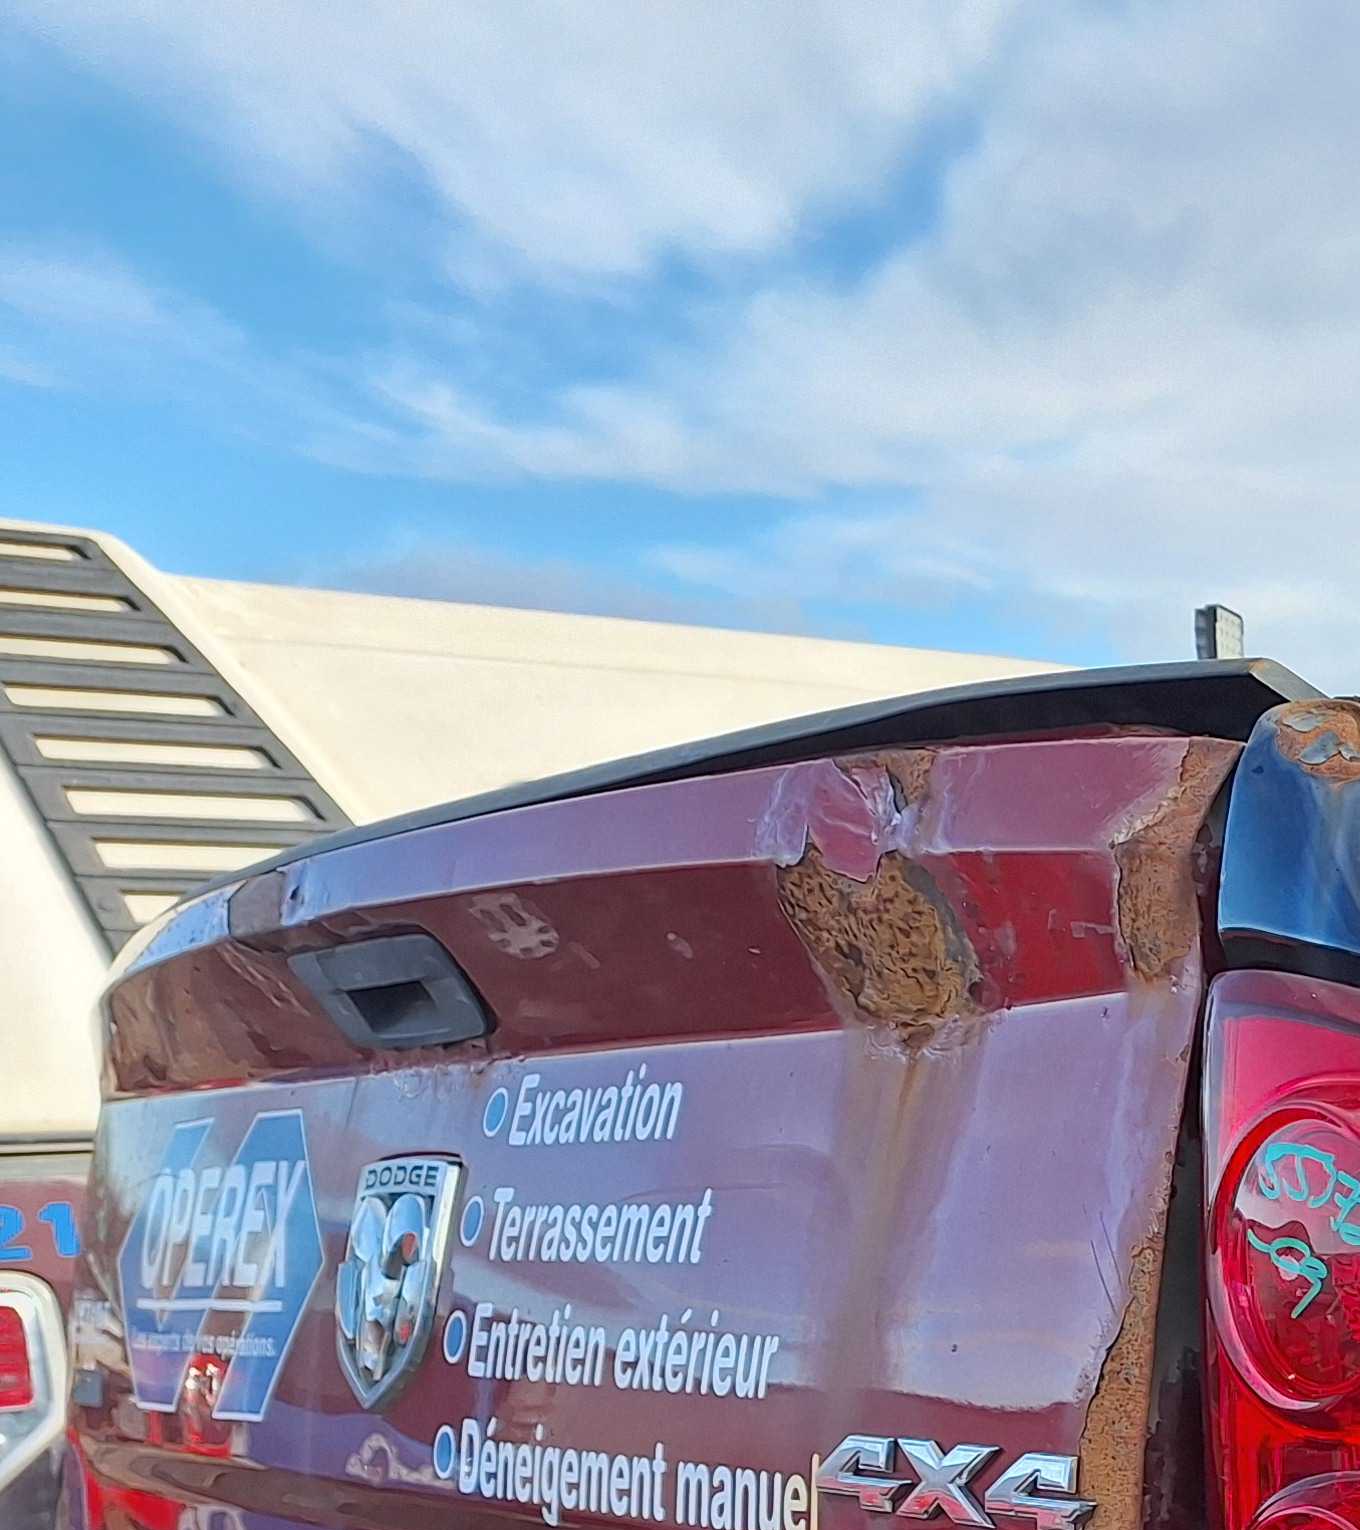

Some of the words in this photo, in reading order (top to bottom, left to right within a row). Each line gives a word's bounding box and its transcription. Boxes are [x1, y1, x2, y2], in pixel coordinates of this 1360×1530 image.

[508, 1062, 684, 1147] Excavation
[365, 1164, 440, 1190] DODGE
[141, 1160, 306, 1290] OPEREX
[486, 1186, 712, 1264] Terrassement
[466, 1305, 605, 1385] Entretien
[613, 1308, 781, 1399] extérieur
[457, 1415, 667, 1527] Déneigement
